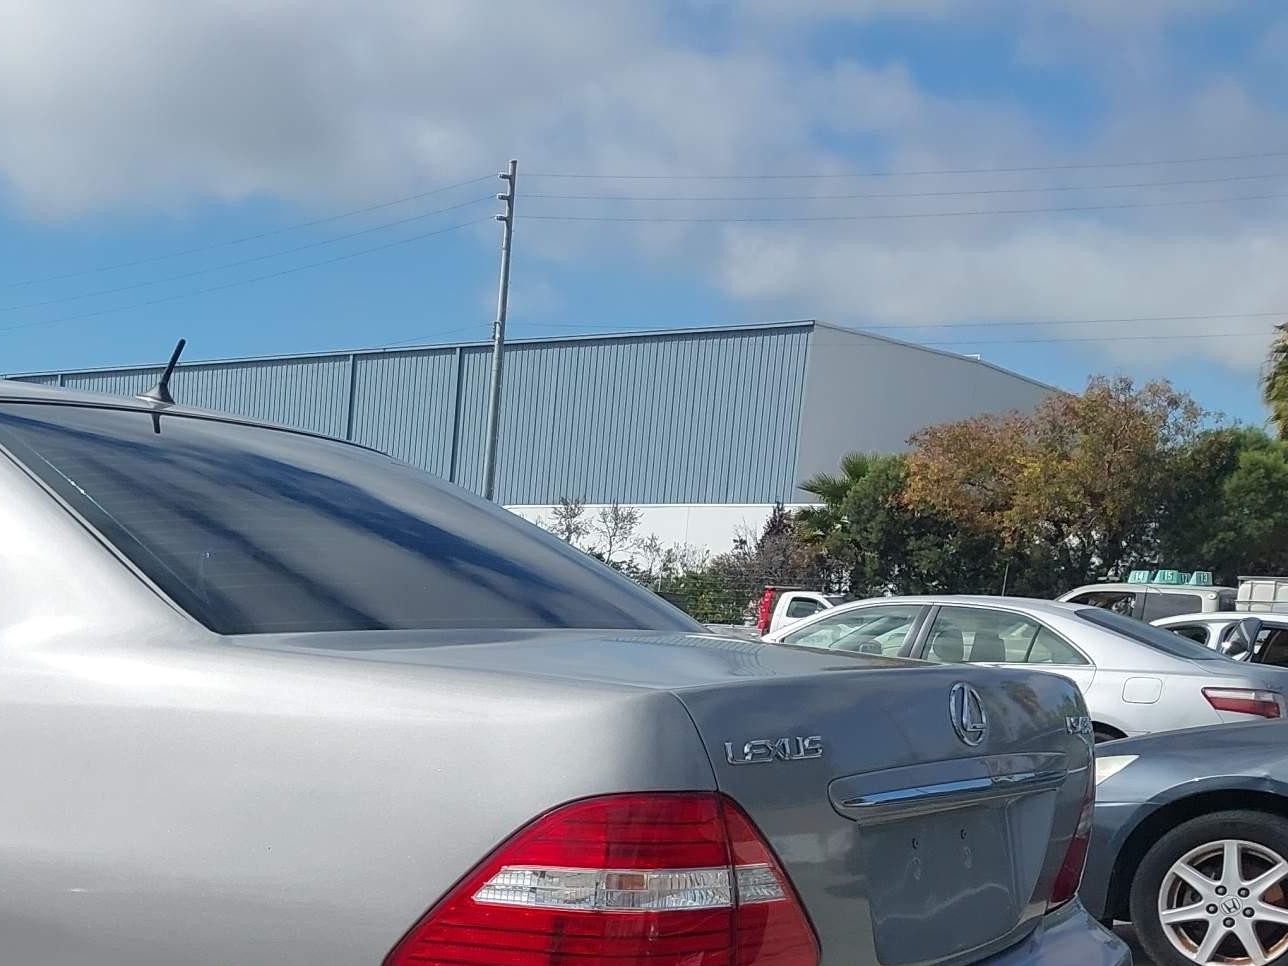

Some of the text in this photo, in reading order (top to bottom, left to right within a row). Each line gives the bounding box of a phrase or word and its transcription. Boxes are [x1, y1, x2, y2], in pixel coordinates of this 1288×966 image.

[1164, 571, 1173, 580] 15
[1200, 573, 1208, 582] 13
[724, 736, 822, 765] LEXUS
